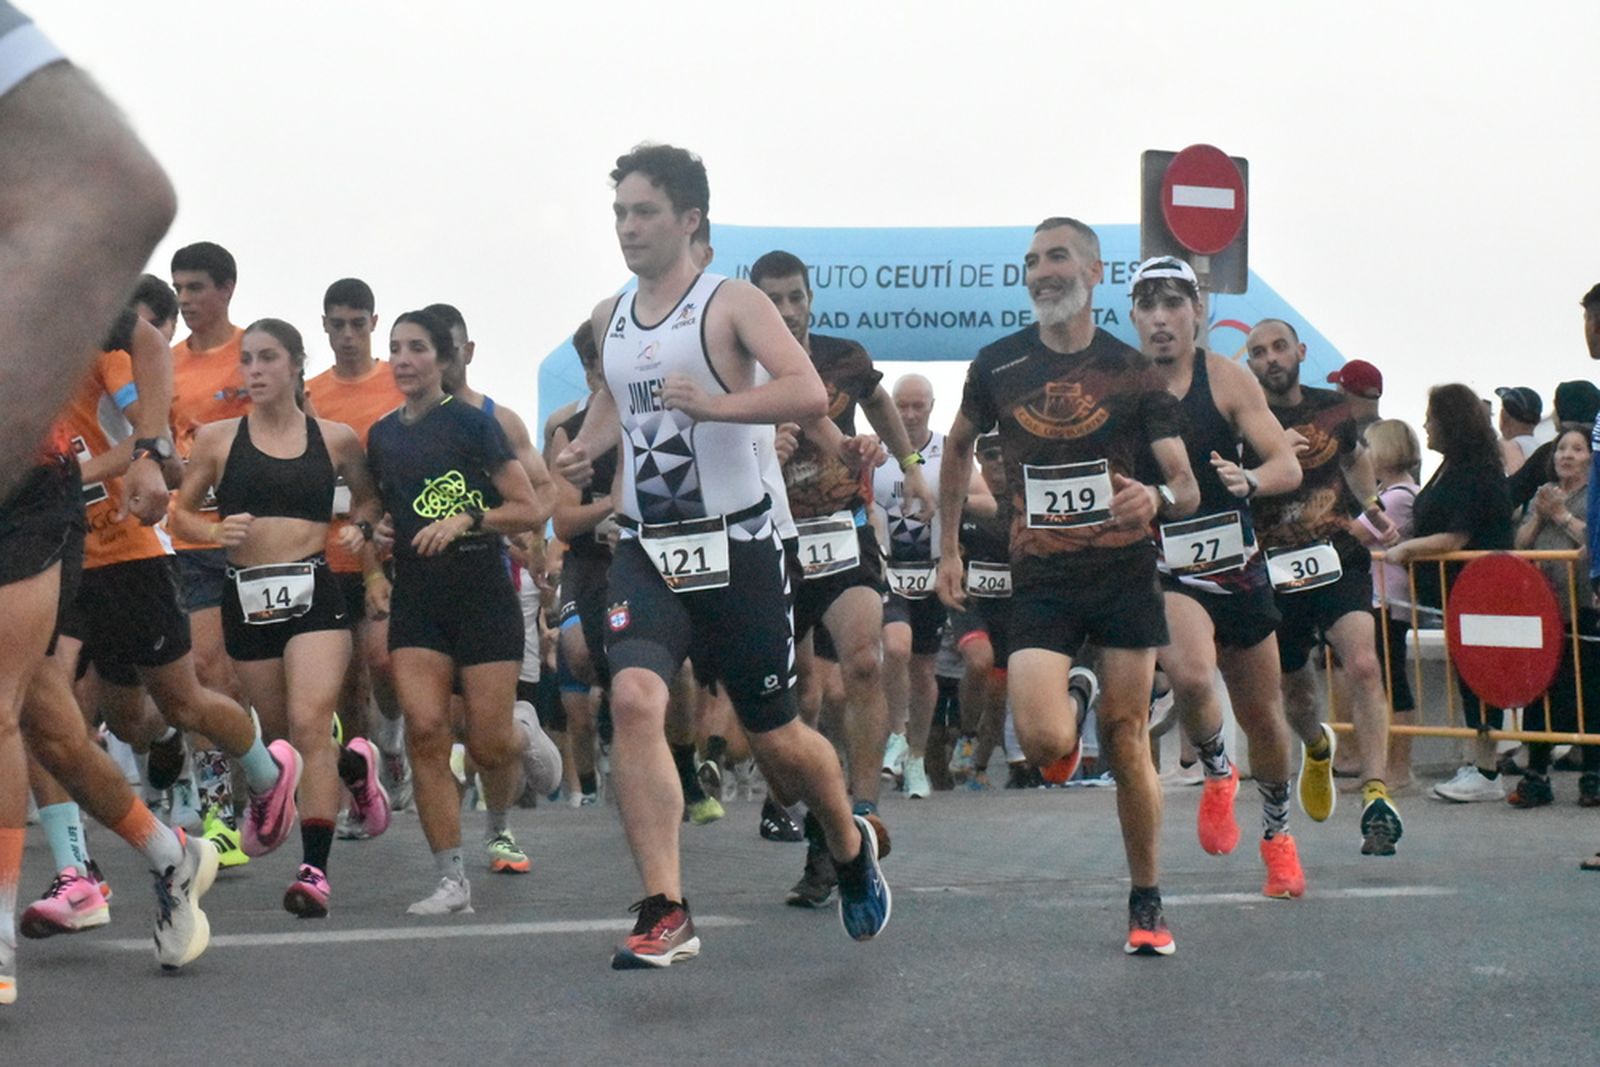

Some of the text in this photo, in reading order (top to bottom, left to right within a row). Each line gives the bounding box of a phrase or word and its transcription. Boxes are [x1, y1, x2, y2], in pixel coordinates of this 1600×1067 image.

[875, 260, 953, 289] CEUTÍ
[960, 264, 994, 288] DE
[856, 307, 994, 329] AUTÓNOMA
[1001, 310, 1032, 328] DE
[1043, 487, 1096, 514] 219
[659, 546, 711, 576] 121
[806, 542, 837, 564] 11
[1190, 538, 1221, 564] 27
[1290, 556, 1320, 580] 30
[898, 575, 927, 591] 120
[977, 575, 1006, 591] 204
[261, 585, 292, 610] 14
